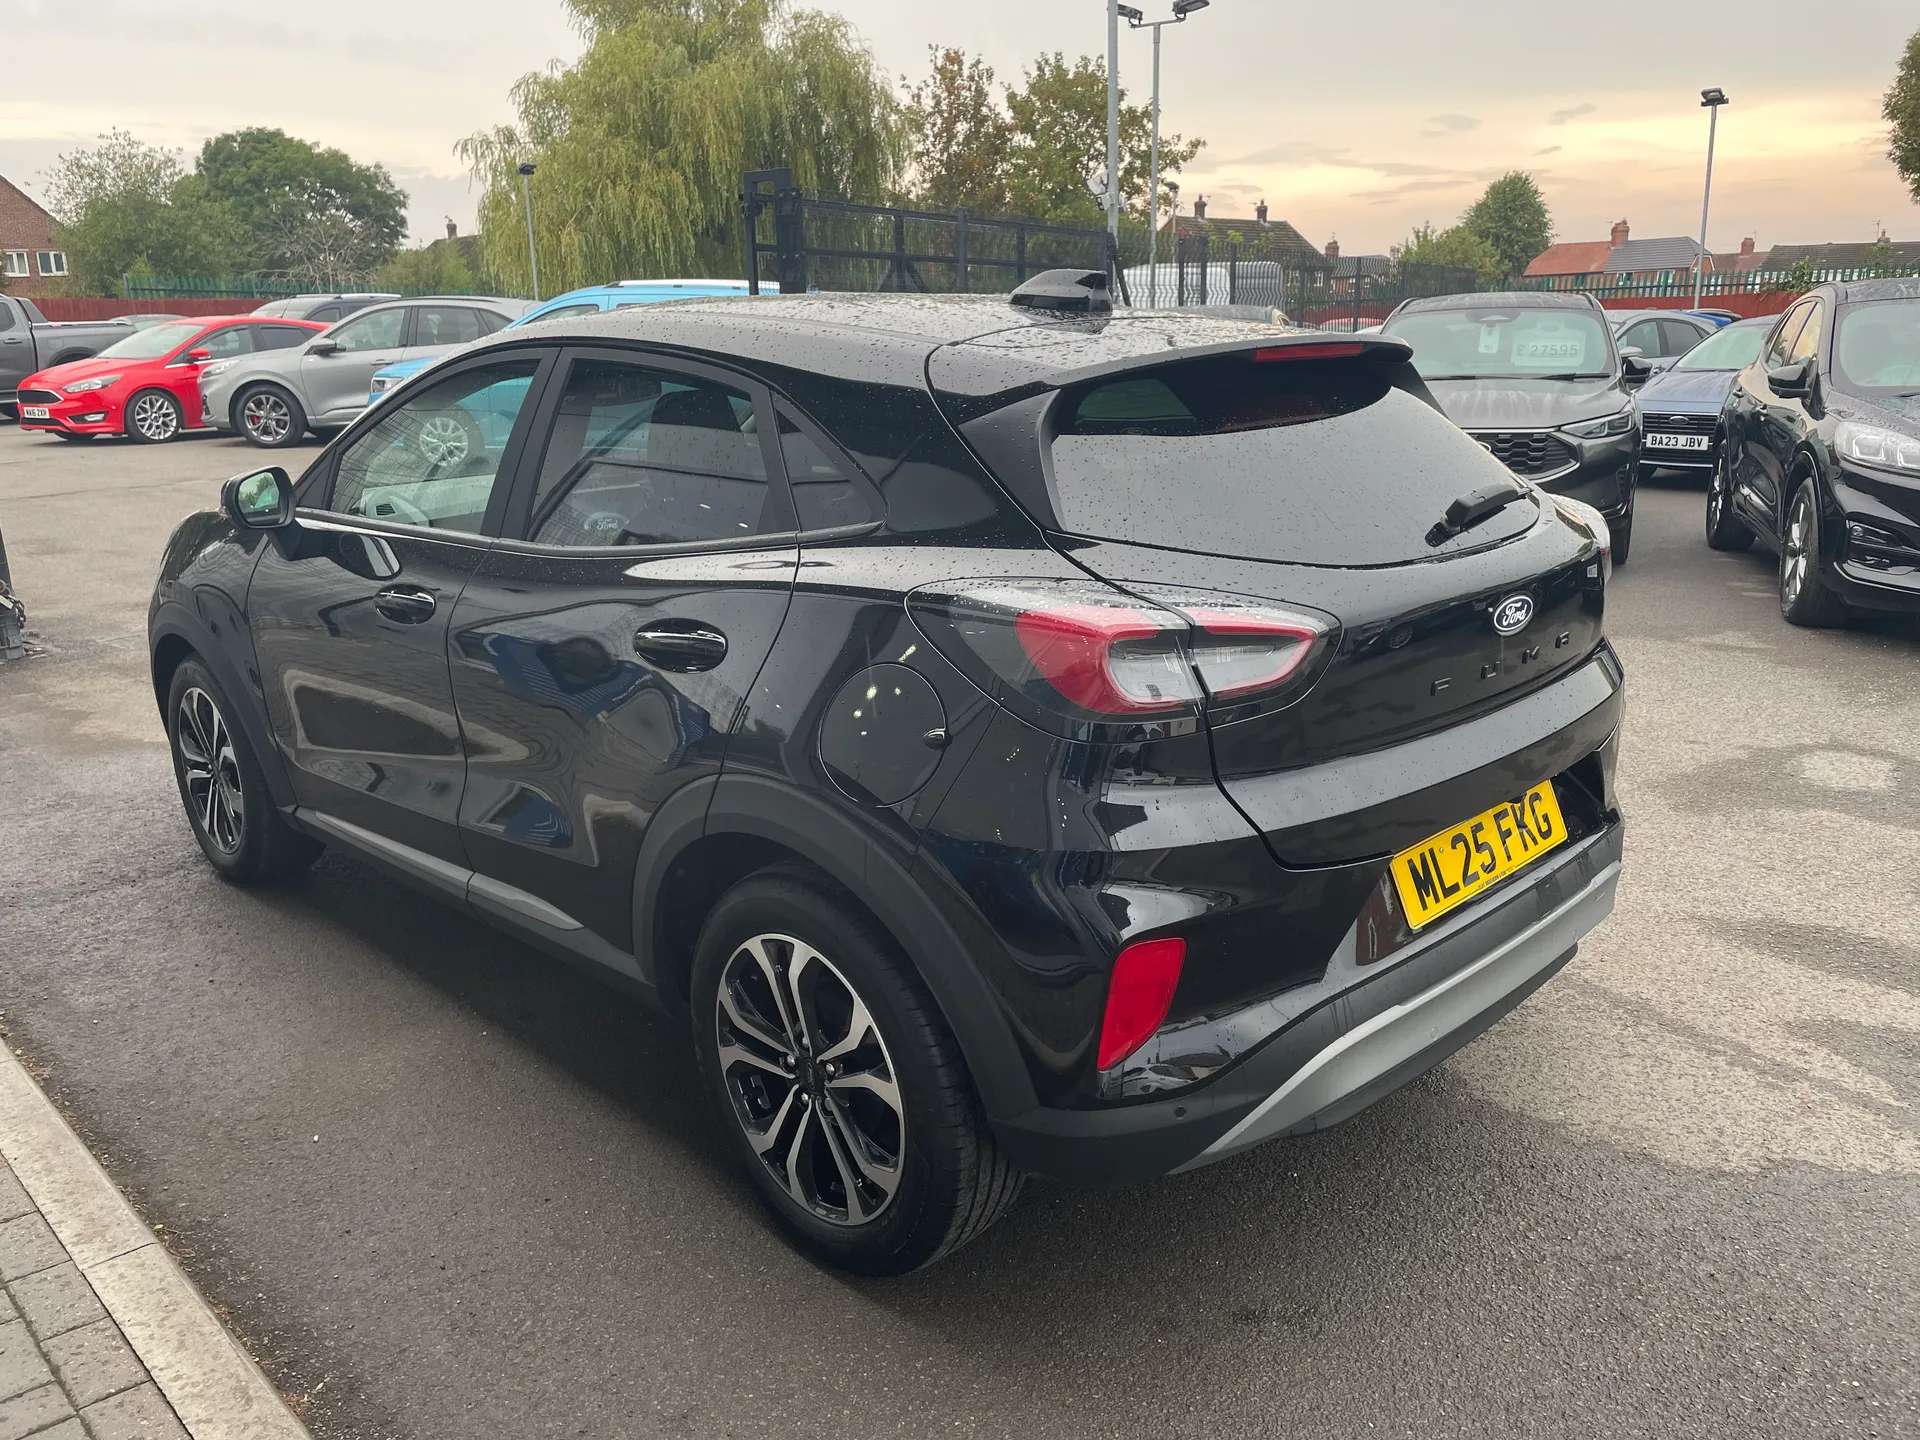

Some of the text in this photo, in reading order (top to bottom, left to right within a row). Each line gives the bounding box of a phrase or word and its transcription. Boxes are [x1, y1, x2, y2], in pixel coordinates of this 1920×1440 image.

[1650, 435, 1704, 449] BA23 JBV
[1501, 600, 1529, 627] Ford
[1407, 791, 1553, 912] ML25 FKG
